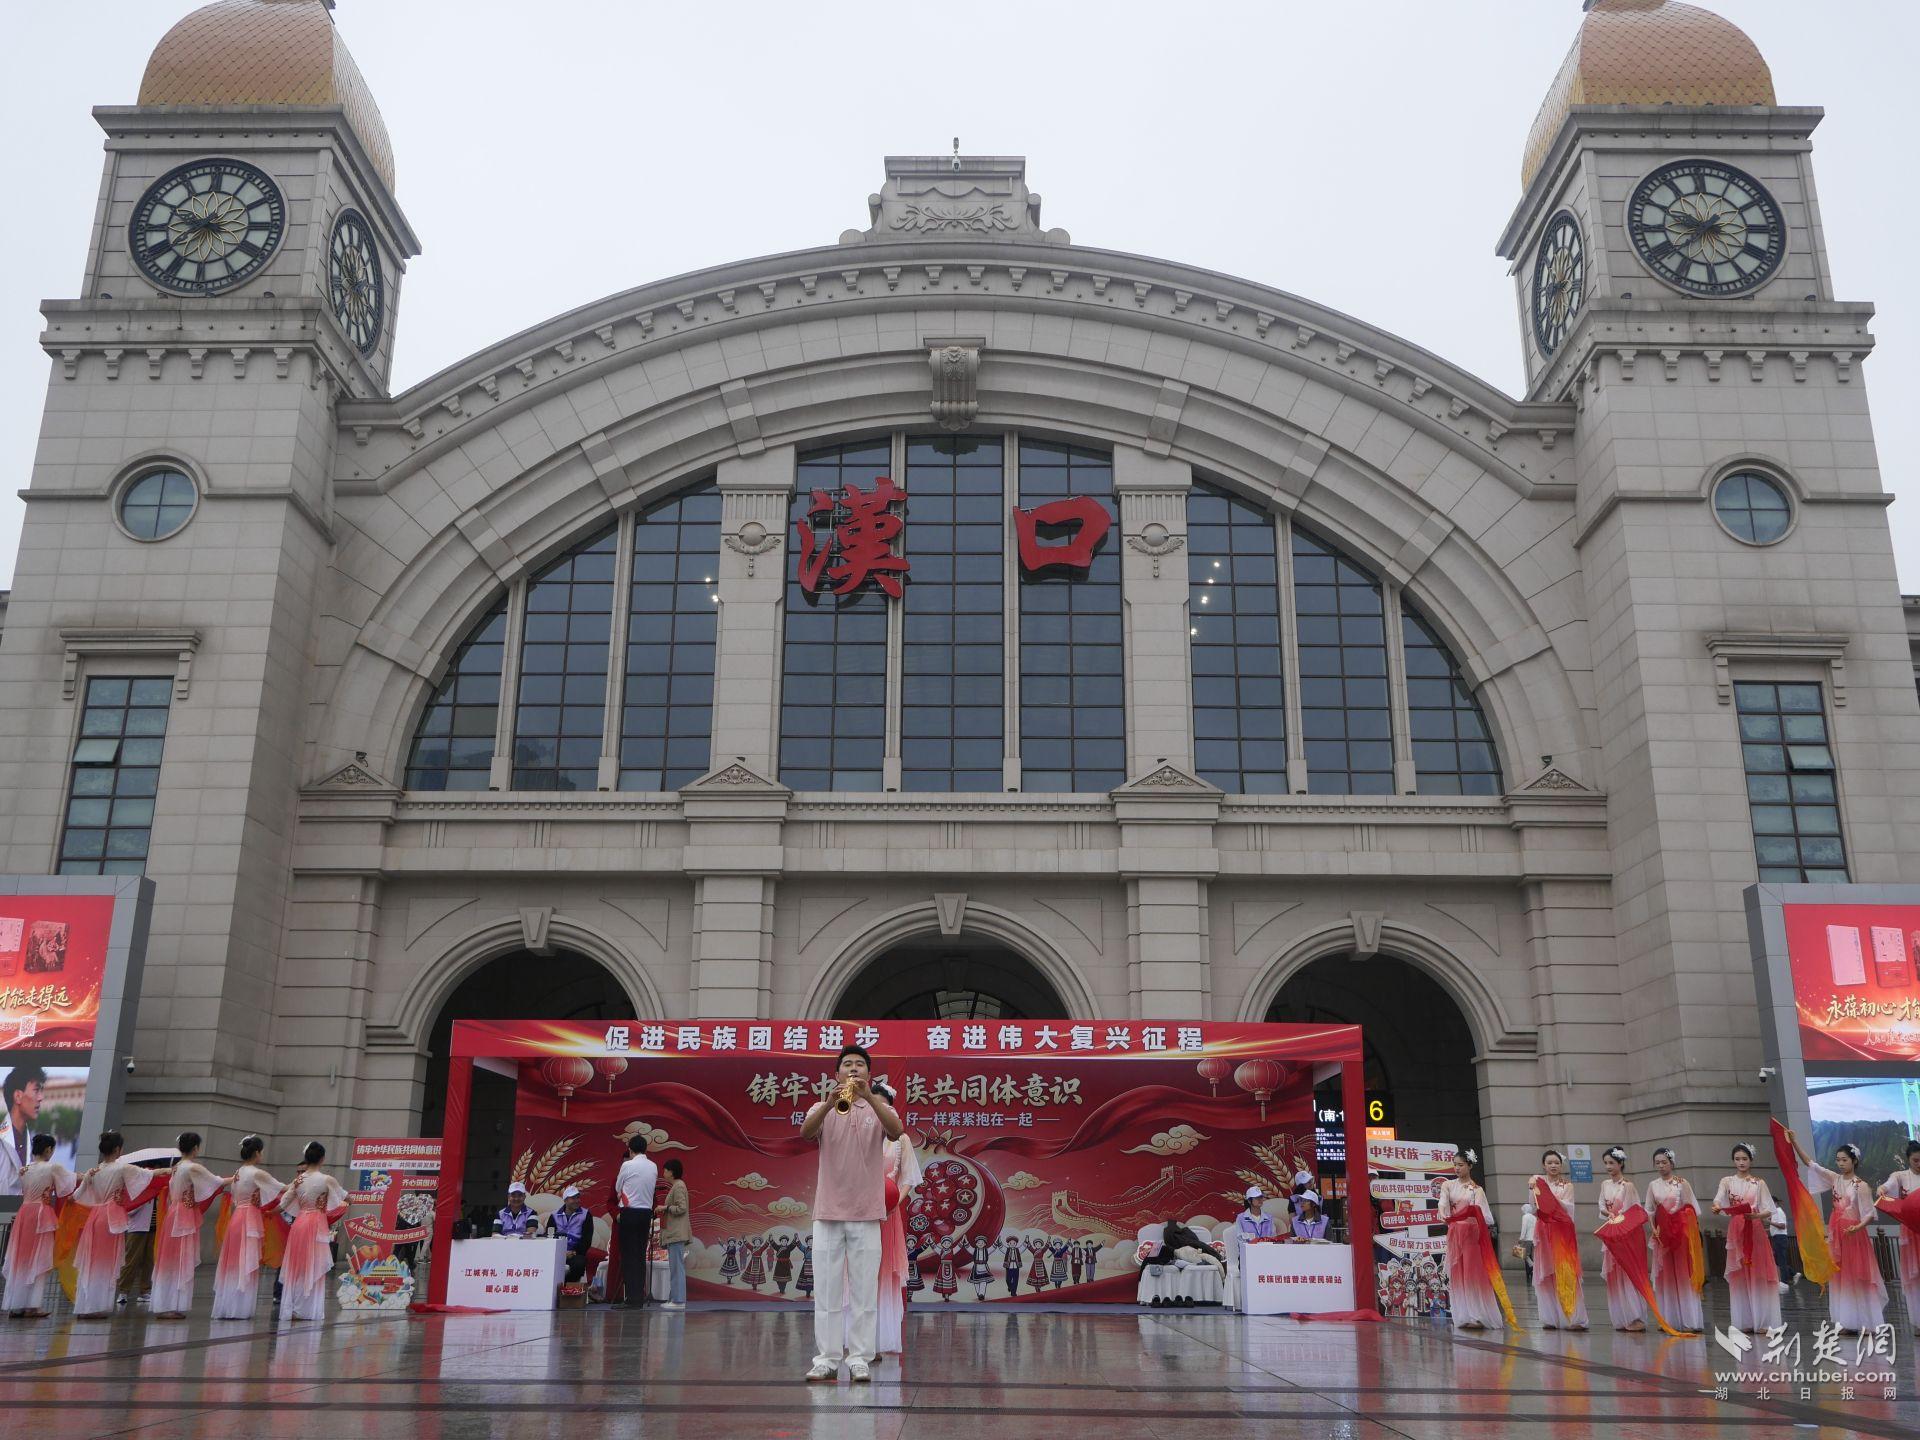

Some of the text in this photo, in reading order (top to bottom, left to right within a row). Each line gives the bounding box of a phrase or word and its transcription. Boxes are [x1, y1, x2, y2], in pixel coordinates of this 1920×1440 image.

[796, 476, 1111, 600] 漢口
[604, 1025, 1204, 1051] 促进民族团结进步 奋进伟大复兴征程
[745, 1072, 1084, 1108] 铸牢中族共同体意识
[1369, 1100, 1384, 1121] 6
[1370, 1145, 1455, 1162] 中华民族一家亲
[1372, 1184, 1430, 1193] 同心共筑中国梦
[1258, 1274, 1342, 1284] 民族团结普法便民驿站
